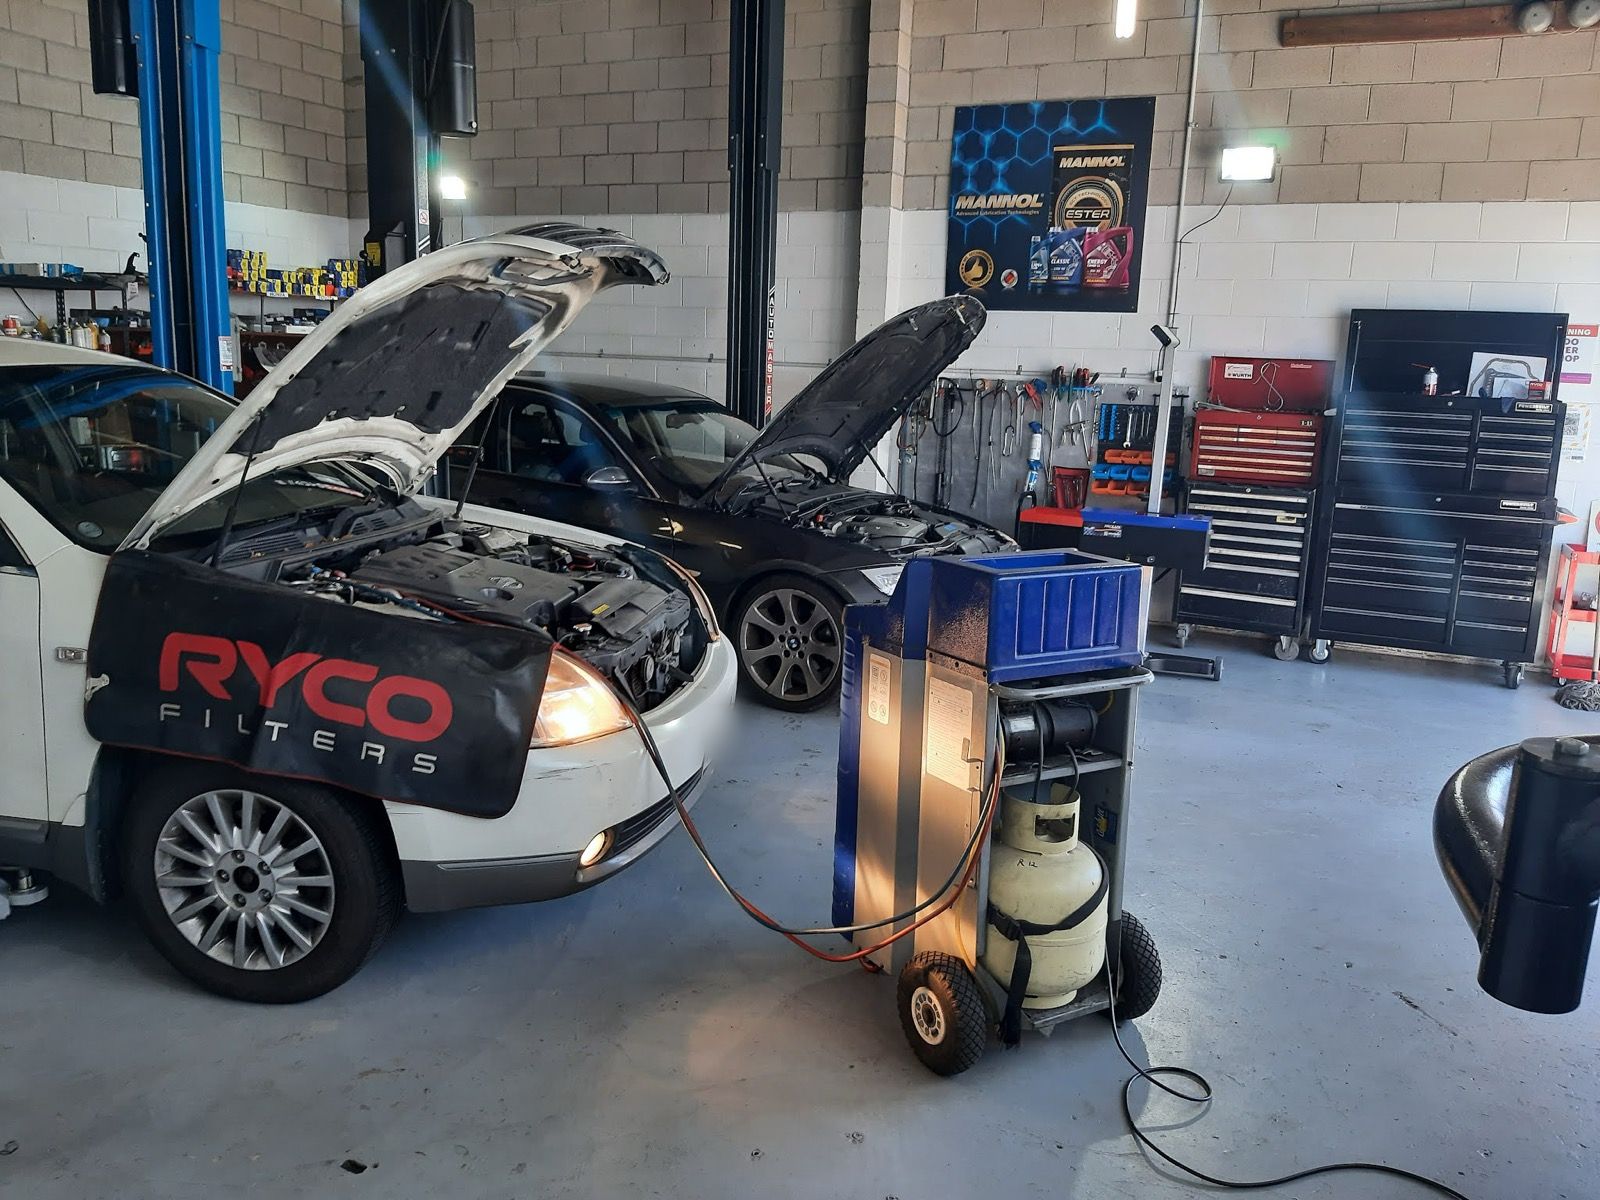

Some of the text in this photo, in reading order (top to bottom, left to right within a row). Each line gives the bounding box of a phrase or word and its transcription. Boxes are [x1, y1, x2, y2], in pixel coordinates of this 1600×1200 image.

[1059, 156, 1125, 168] MANNOL
[955, 193, 1043, 209] MANNOL
[1066, 209, 1110, 219] ESTER
[159, 632, 453, 742] RYCO
[160, 703, 438, 774] FILTERS
